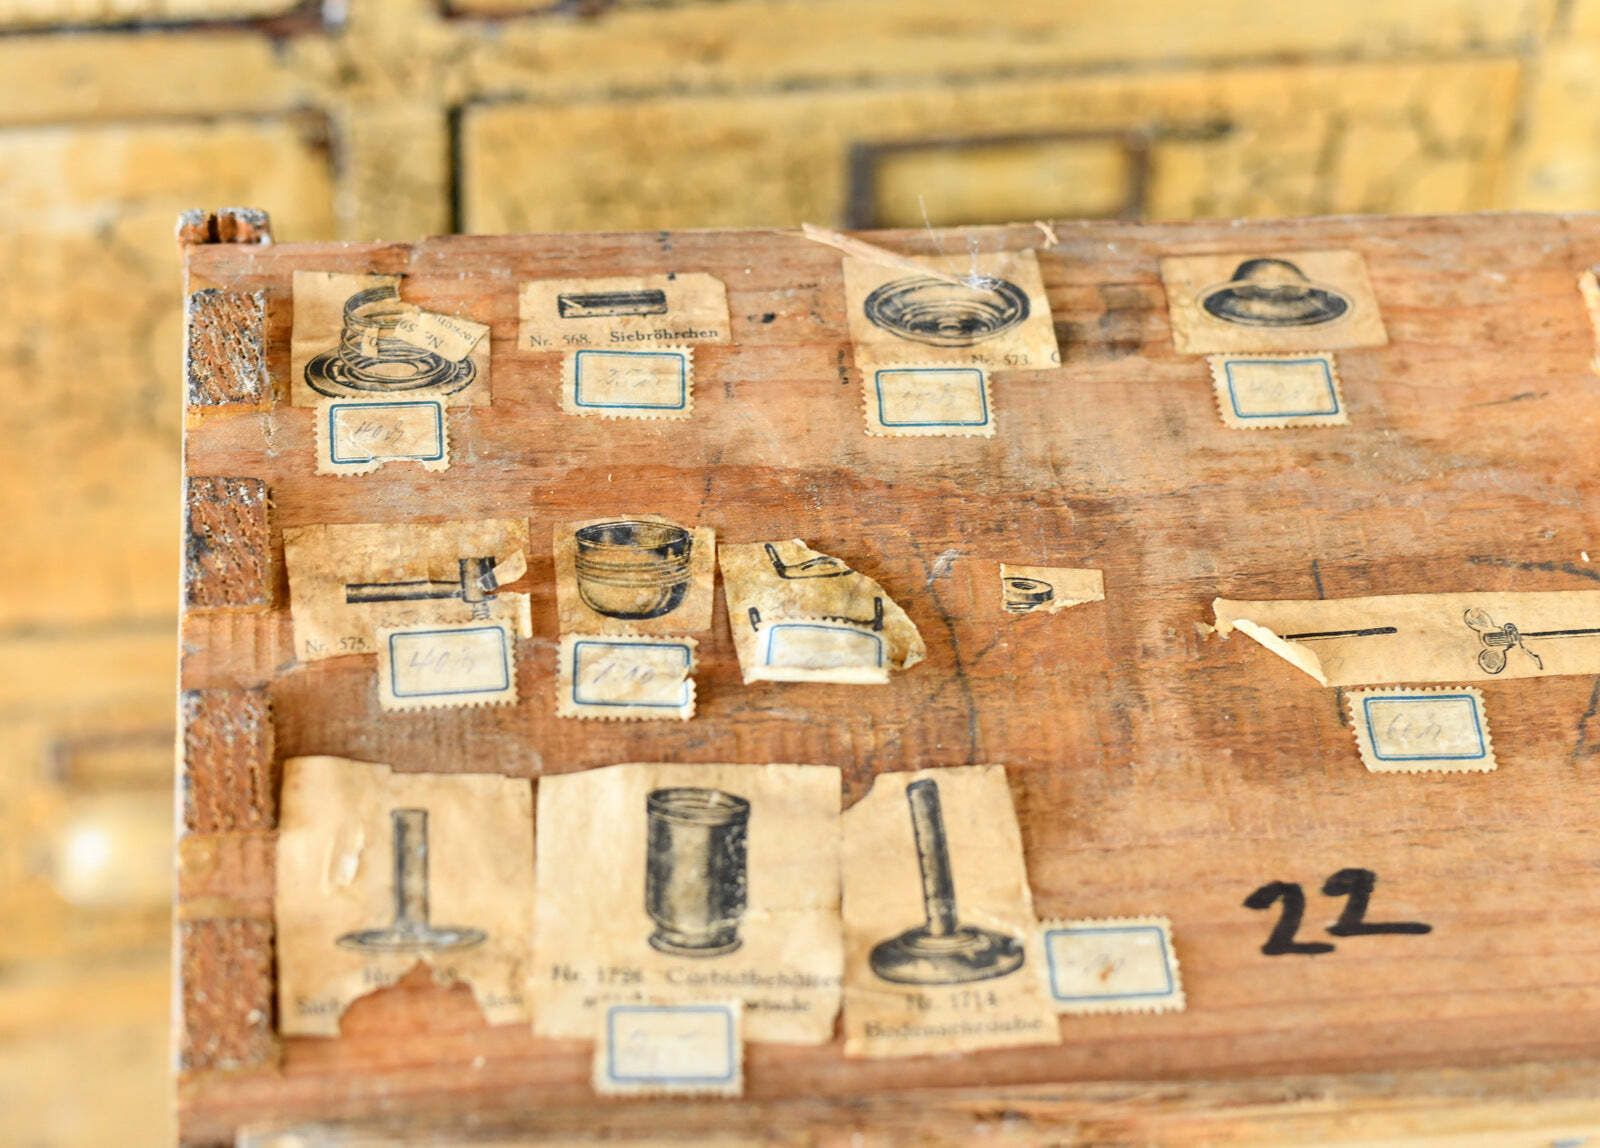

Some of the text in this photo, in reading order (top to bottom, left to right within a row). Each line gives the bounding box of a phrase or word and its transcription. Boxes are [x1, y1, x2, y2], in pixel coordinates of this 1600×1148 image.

[530, 335, 553, 347] Nr.
[610, 328, 718, 343] Siebröhrchen
[1243, 868, 1432, 956] 22
